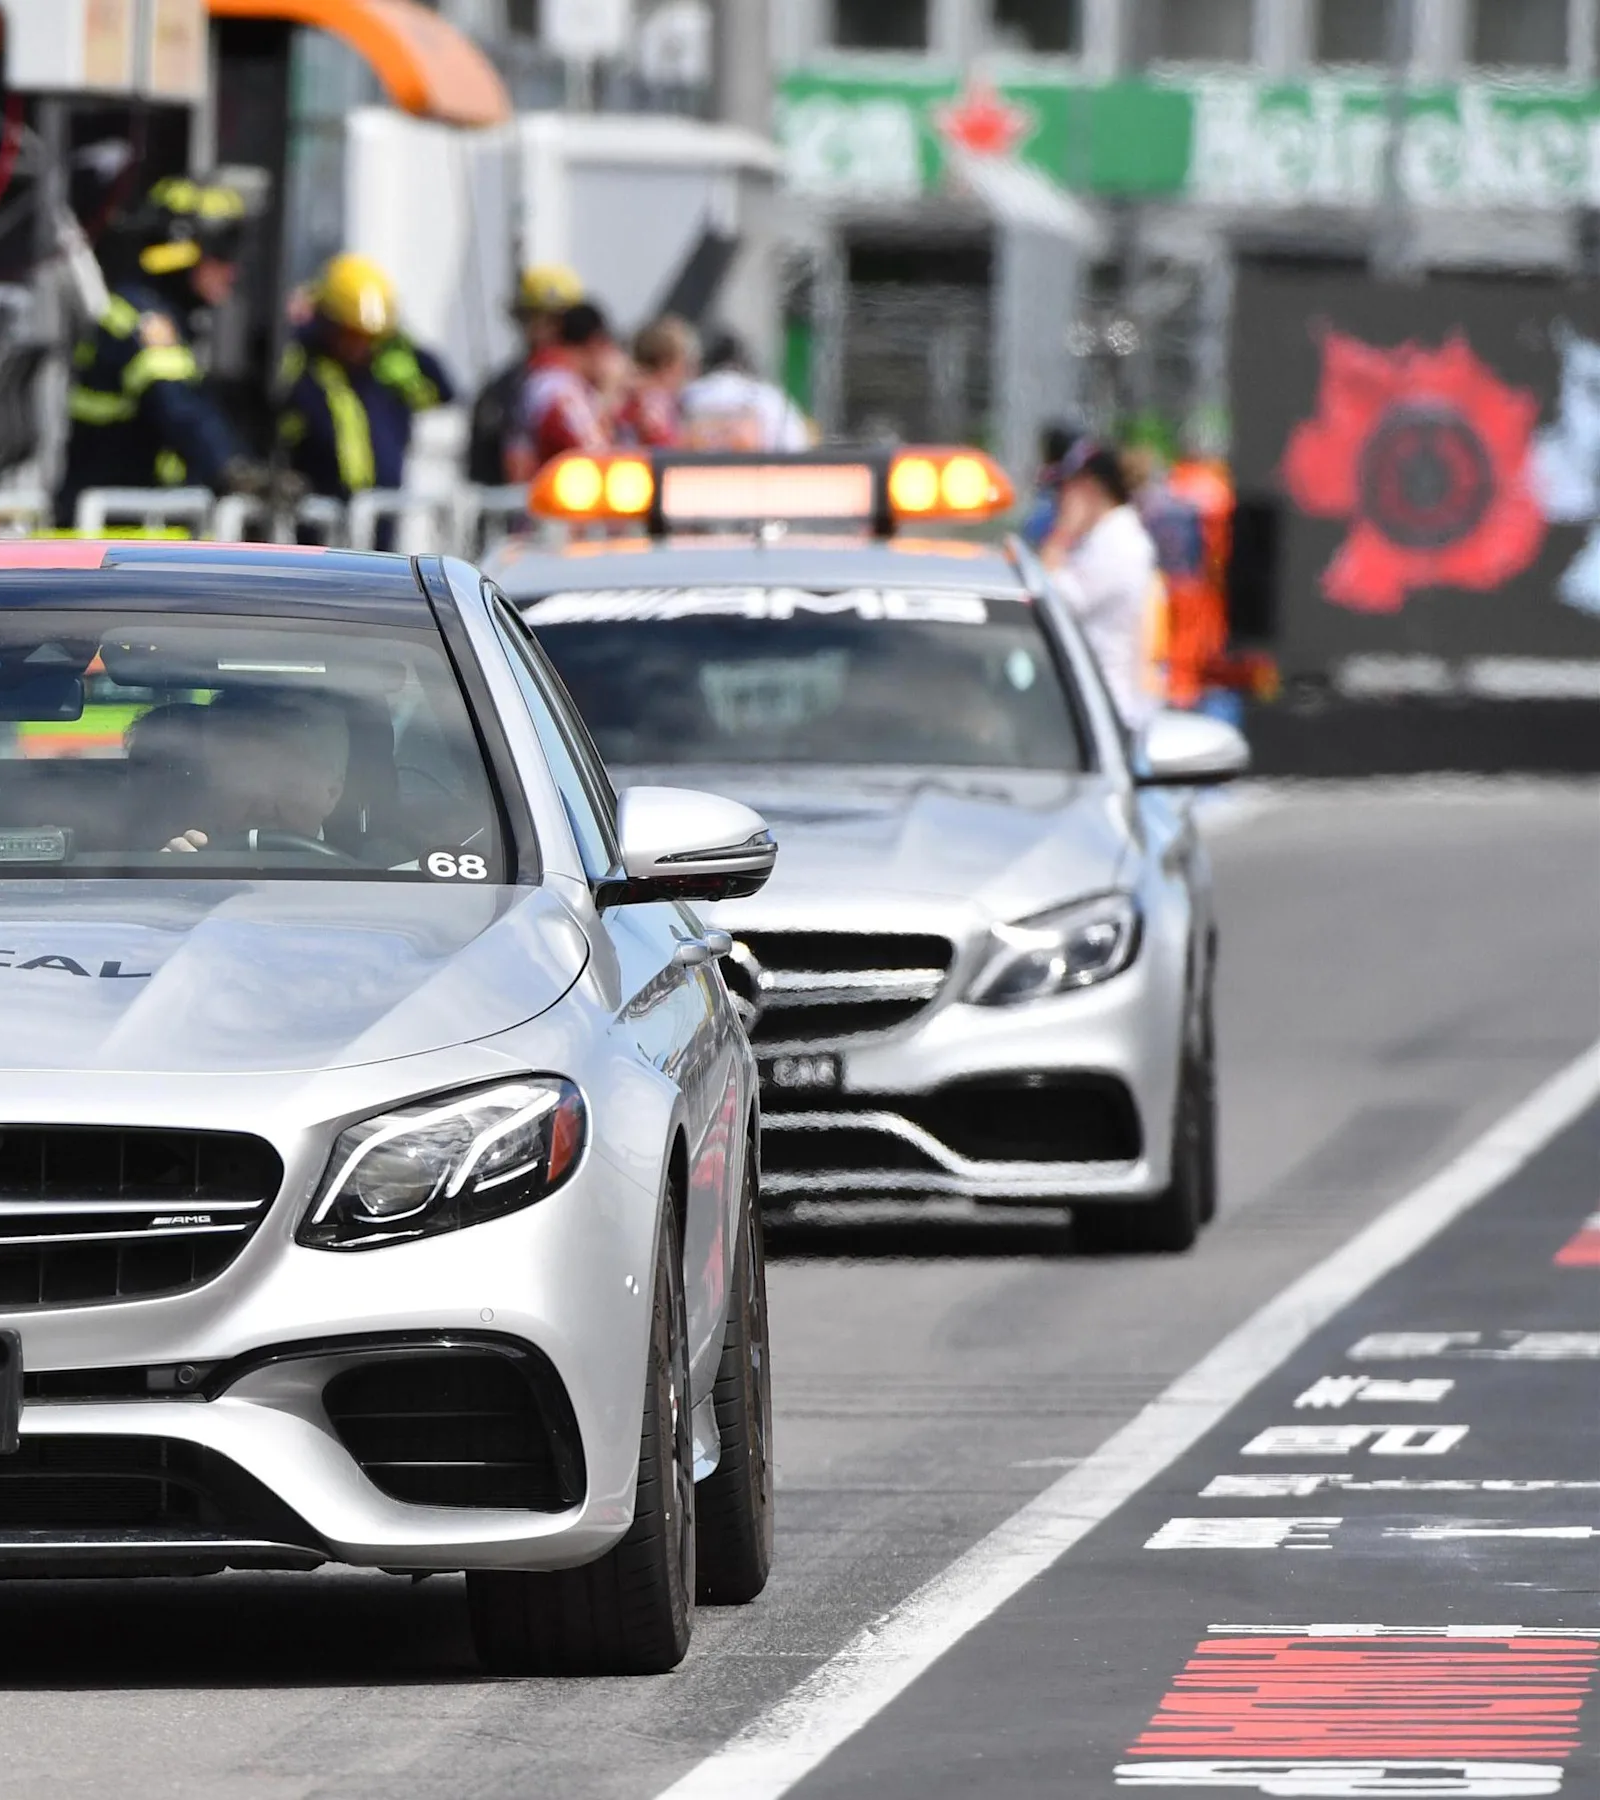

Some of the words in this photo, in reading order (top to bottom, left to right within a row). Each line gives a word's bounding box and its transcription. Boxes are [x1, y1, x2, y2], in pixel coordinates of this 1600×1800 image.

[1193, 80, 1600, 200] Heineke
[427, 851, 488, 880] 68
[171, 1215, 211, 1224] AMG
